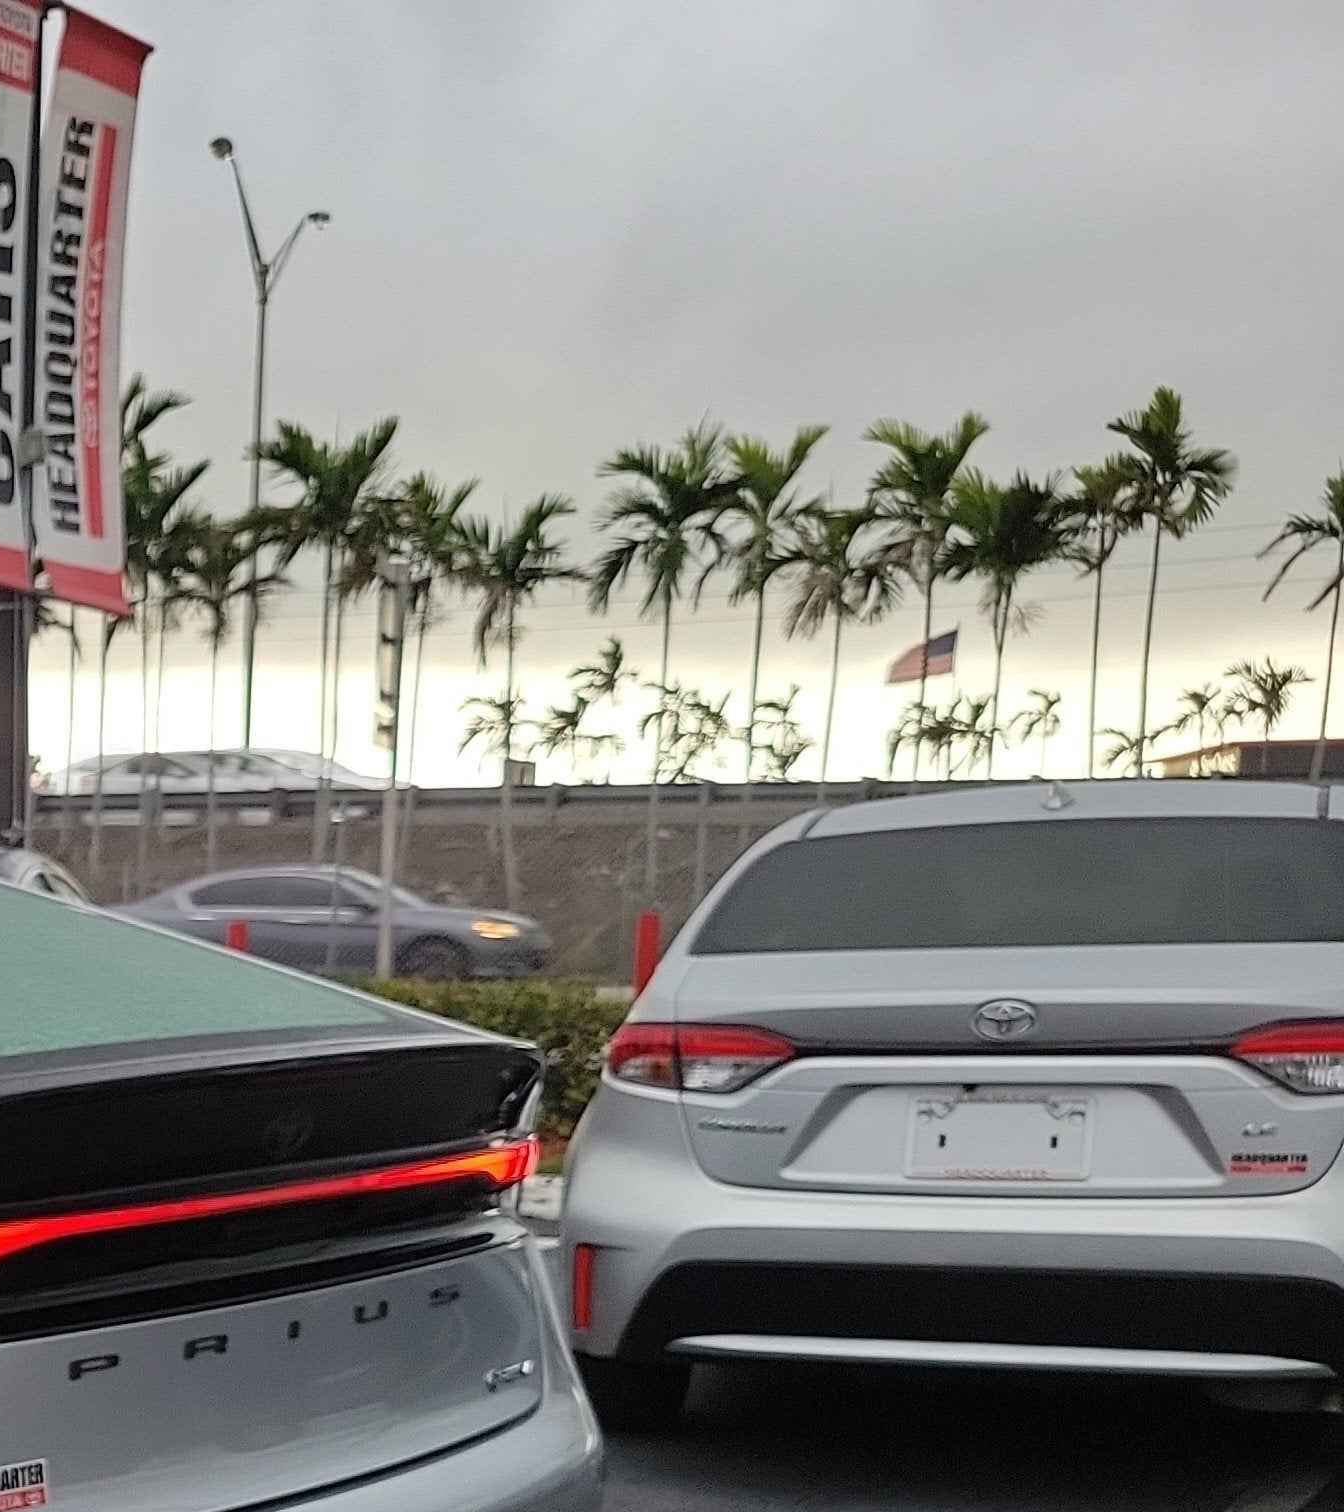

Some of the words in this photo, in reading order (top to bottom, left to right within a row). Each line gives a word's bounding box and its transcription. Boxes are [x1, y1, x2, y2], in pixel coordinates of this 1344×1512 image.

[45, 117, 95, 534] HEADQUARTER
[81, 240, 106, 391] TOYOTA
[68, 1284, 461, 1381] PRIUS
